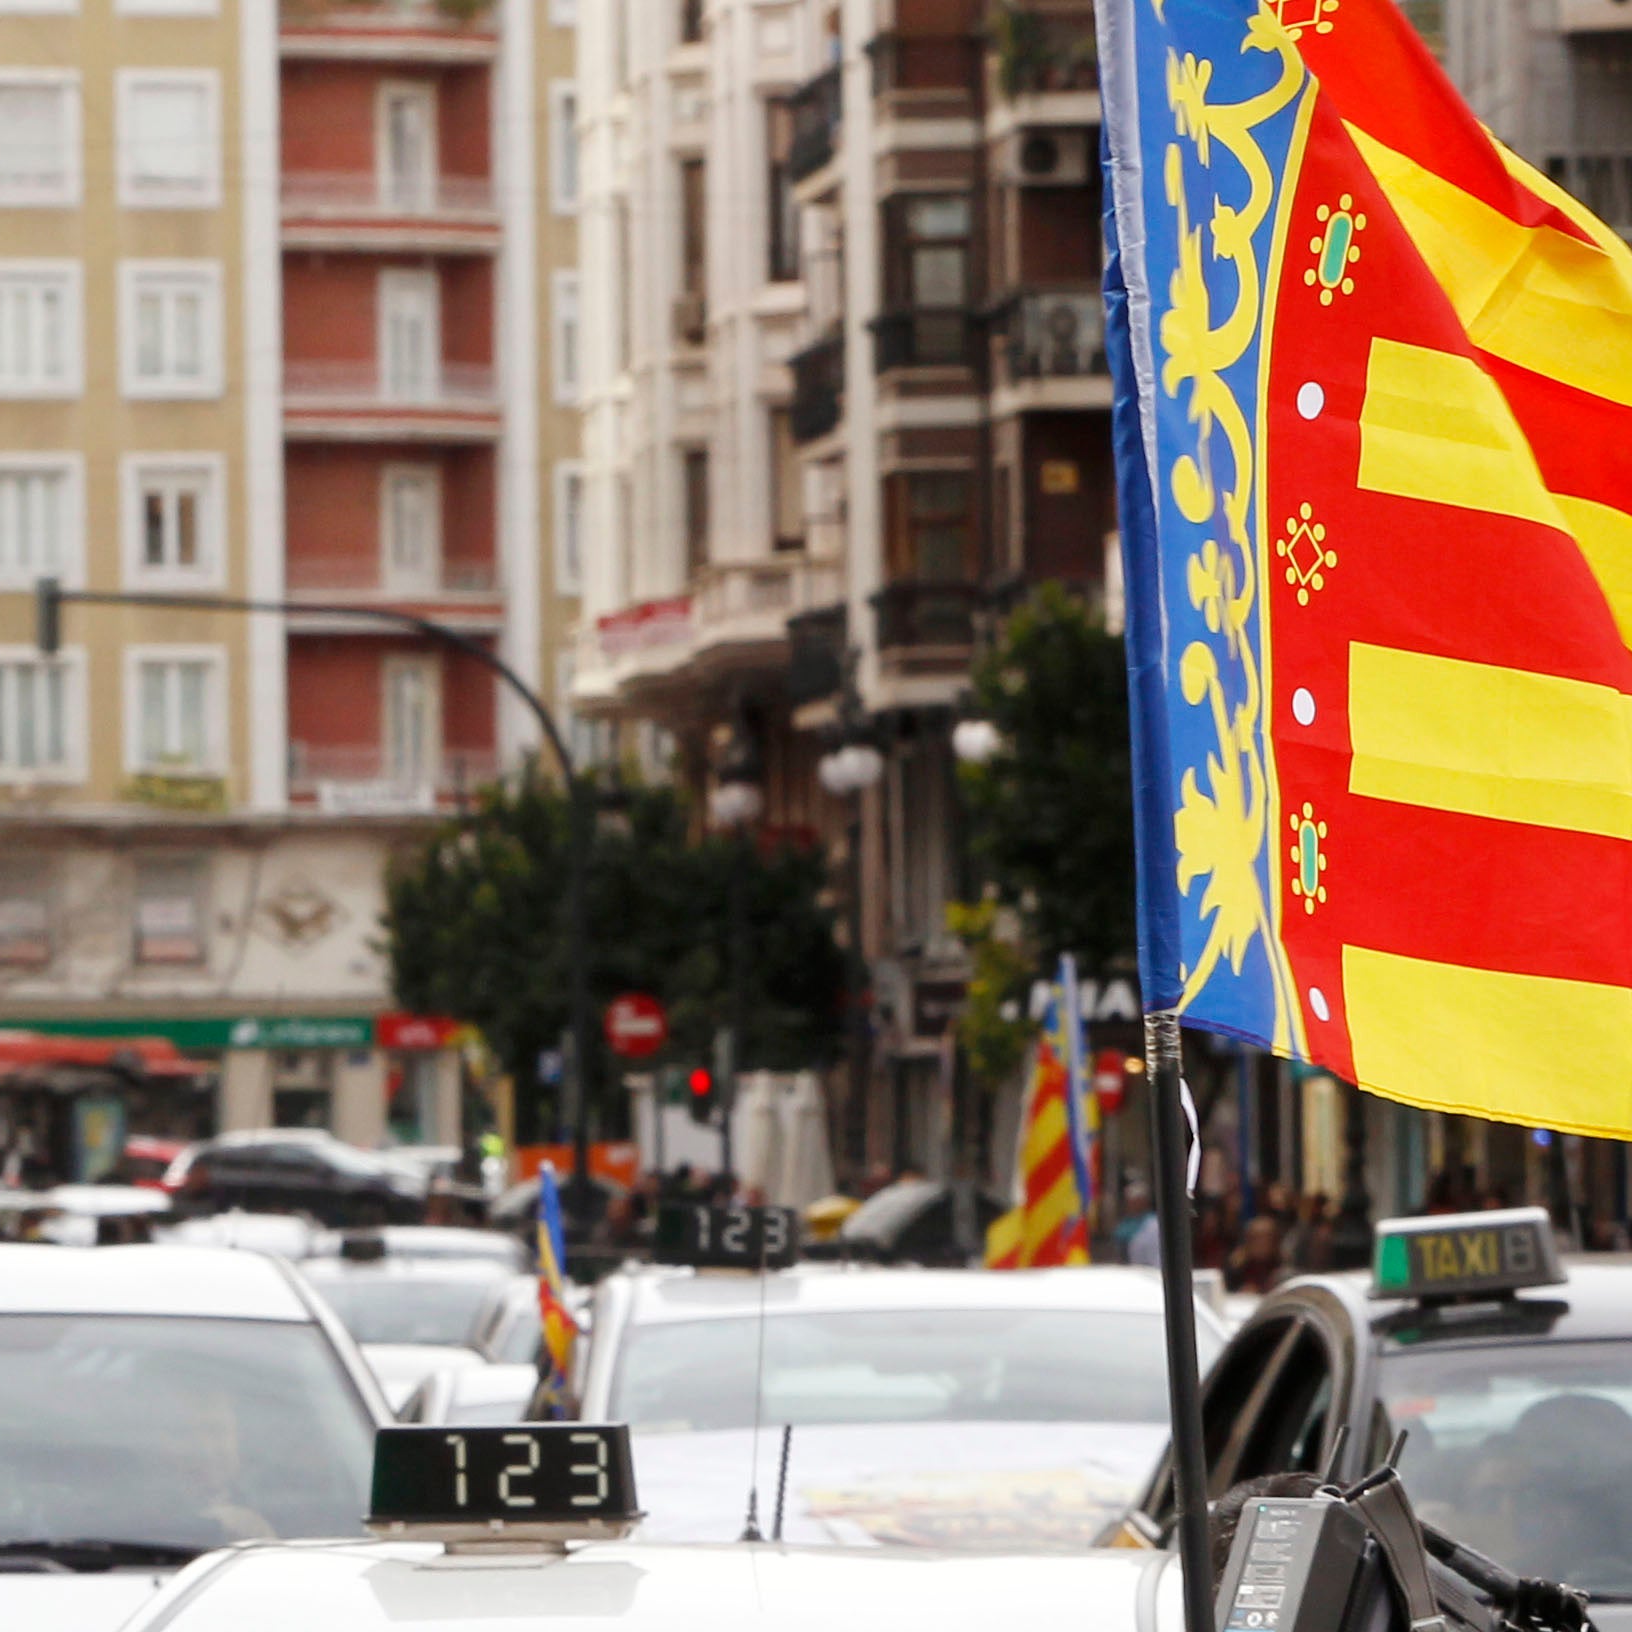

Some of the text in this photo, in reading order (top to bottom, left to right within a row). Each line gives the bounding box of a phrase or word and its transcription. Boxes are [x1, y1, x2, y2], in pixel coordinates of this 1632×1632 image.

[694, 1205, 788, 1253] 123
[1417, 1229, 1500, 1281] TAXI
[445, 1433, 609, 1507] 123
